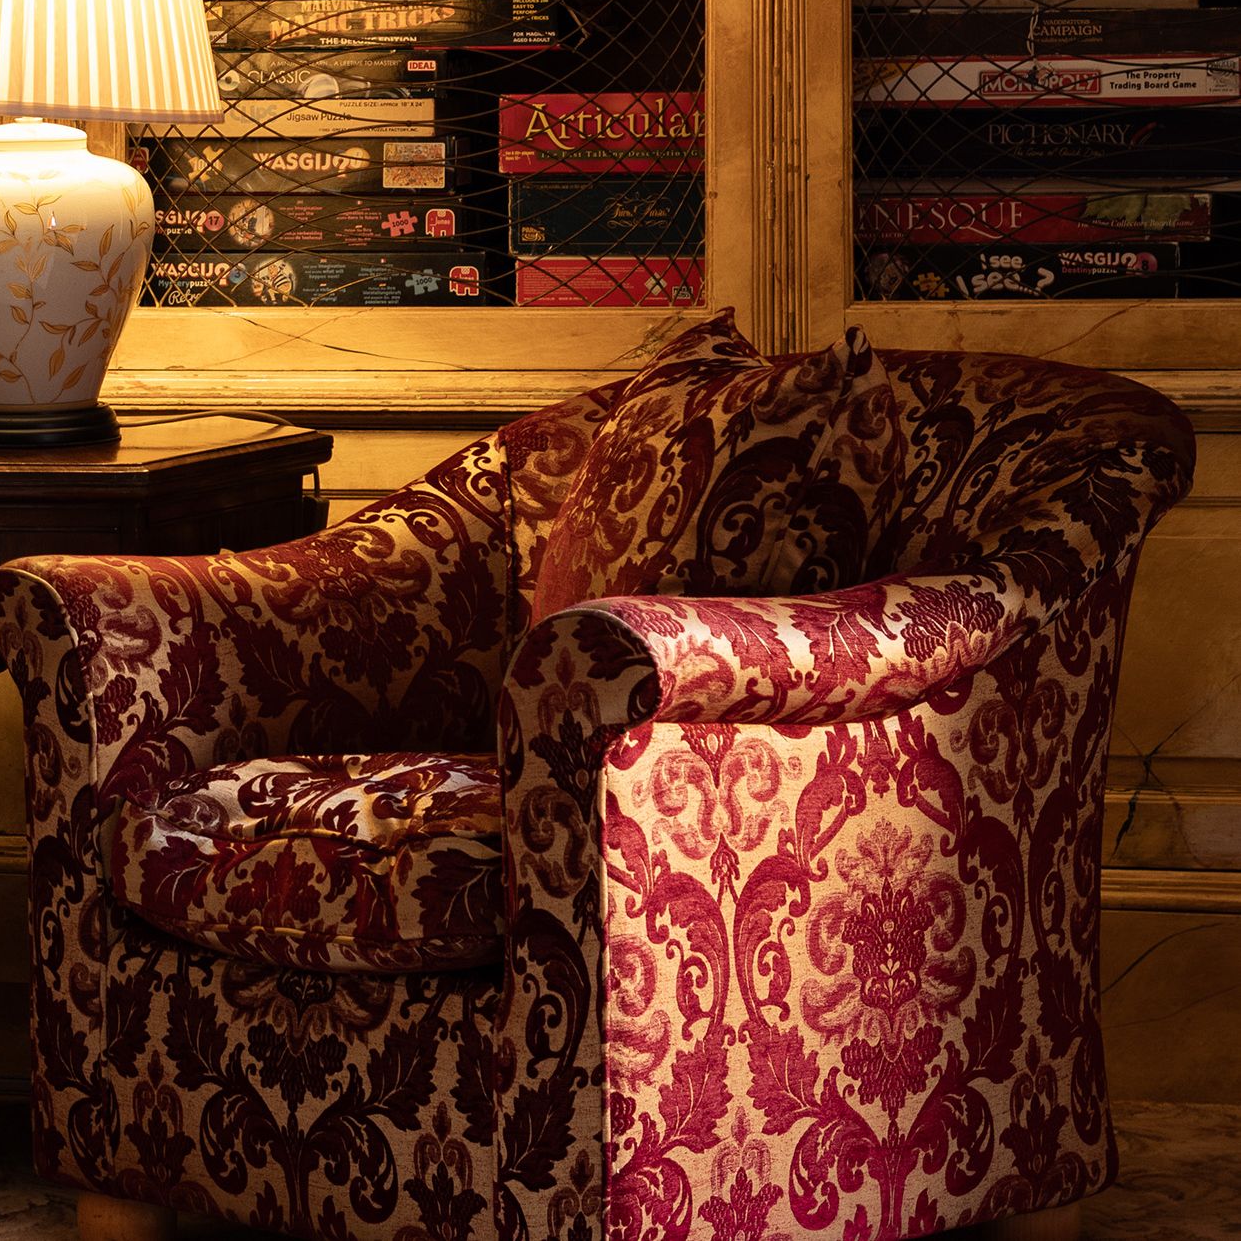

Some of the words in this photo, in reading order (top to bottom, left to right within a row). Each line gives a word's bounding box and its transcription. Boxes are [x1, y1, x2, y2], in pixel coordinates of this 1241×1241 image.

[270, 13, 352, 42] MAGIC
[362, 6, 456, 31] TRICKS
[1033, 26, 1102, 36] CAMPAIGN
[408, 60, 435, 70] IDEAL
[248, 70, 310, 84] CLASSIC
[1146, 71, 1180, 80] Property
[984, 75, 1097, 93] MONOPOLY
[1110, 82, 1142, 90] Trading
[1144, 81, 1170, 89] Board
[1172, 81, 1196, 89] Game
[286, 112, 318, 122] Jigsaw
[320, 112, 352, 121] Puzzle
[988, 124, 1132, 144] PICTIONARY
[208, 216, 220, 226] 17
[392, 220, 408, 228] 1000
[416, 278, 432, 286] 1000
